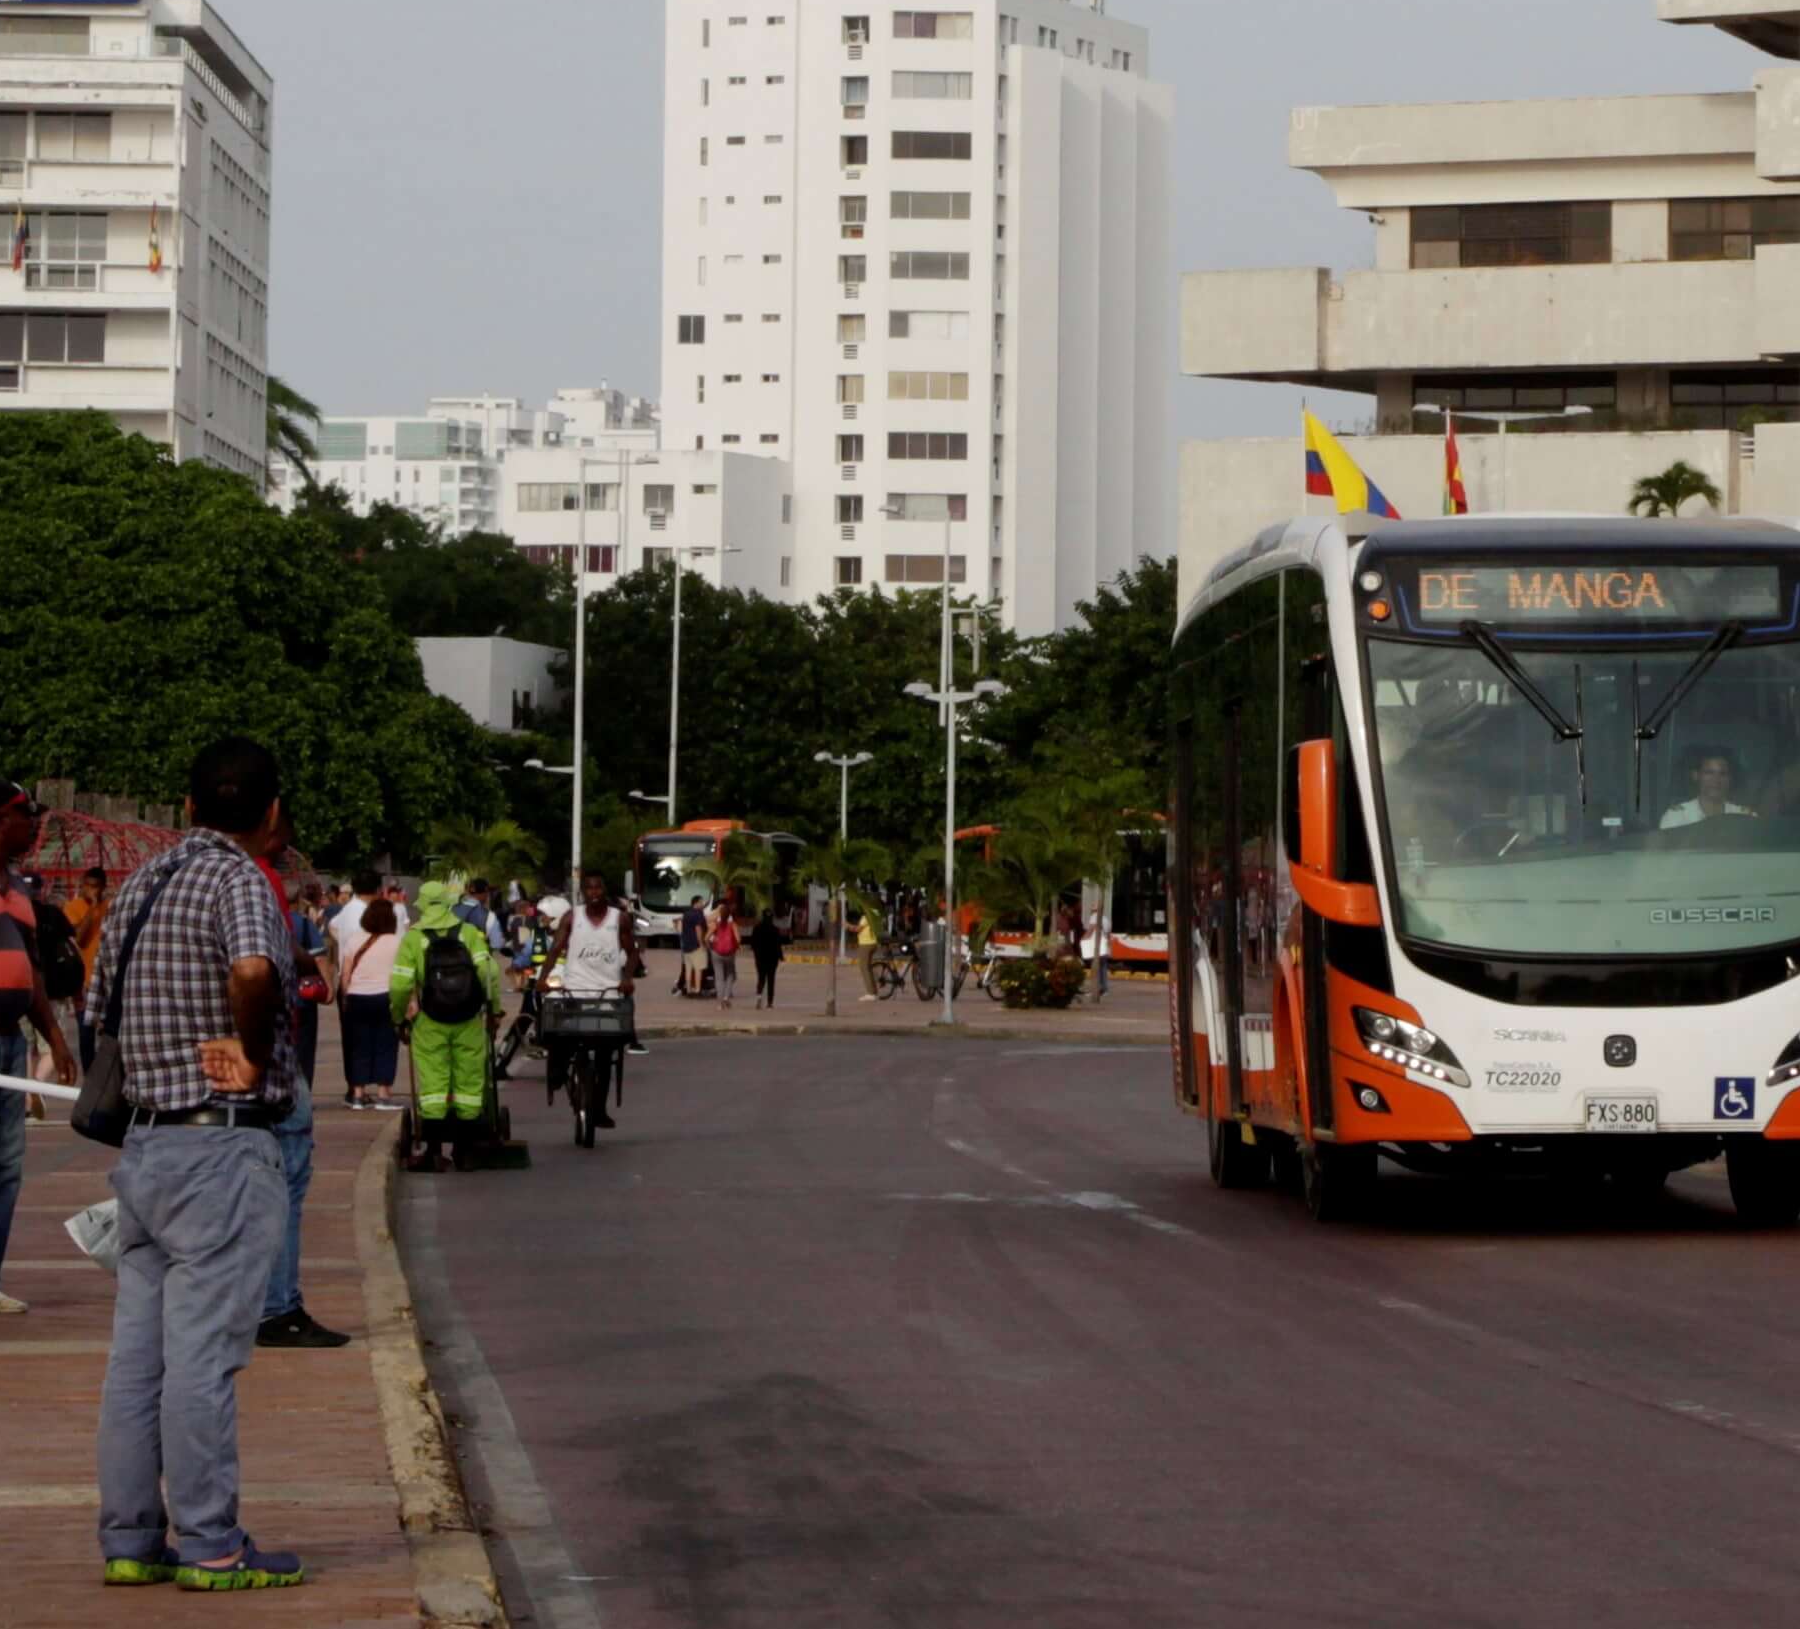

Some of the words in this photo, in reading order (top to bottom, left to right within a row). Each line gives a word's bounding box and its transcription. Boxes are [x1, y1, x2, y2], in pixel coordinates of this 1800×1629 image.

[1419, 574, 1479, 609] DE
[1508, 571, 1664, 609] MANGA
[1650, 907, 1775, 923] BUSSCAR
[1486, 1071, 1561, 1086] TC22020
